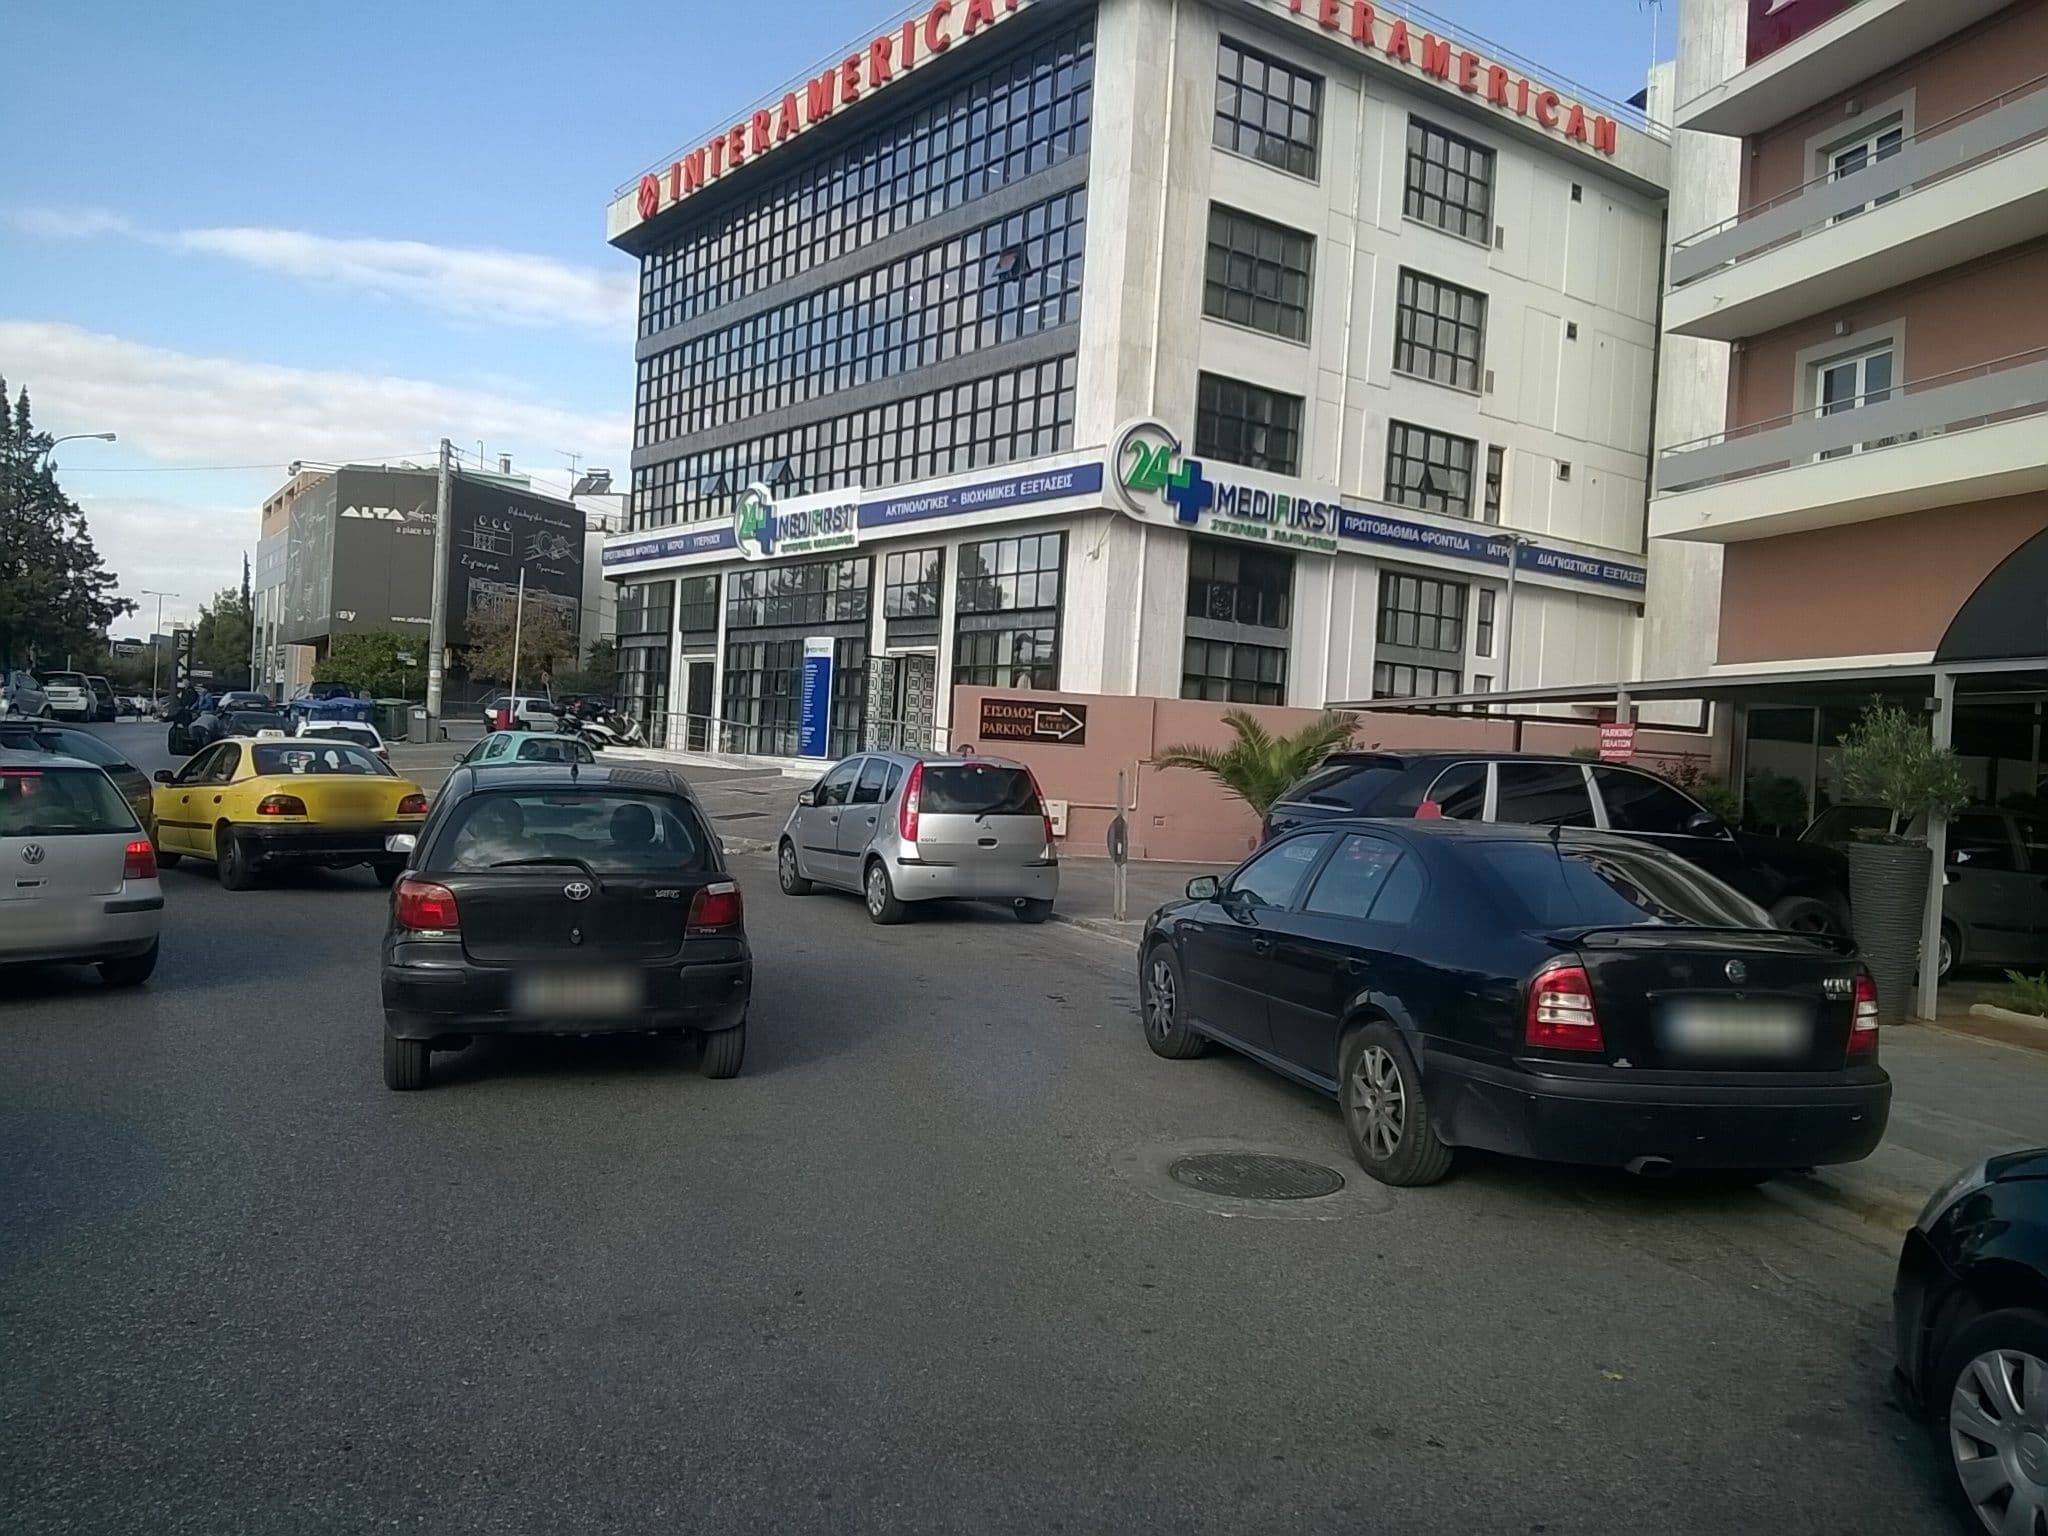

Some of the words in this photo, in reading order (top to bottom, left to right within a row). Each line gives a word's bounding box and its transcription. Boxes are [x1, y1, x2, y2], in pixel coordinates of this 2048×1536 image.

[669, 0, 1018, 201] INTERAMERICA
[1289, 0, 1617, 156] ERAMERICAN
[1124, 440, 1171, 493] 24
[340, 505, 405, 521] ALTA
[885, 498, 950, 517] ΑΚΤΙΝΟΛΟΓΙΚΕΣ
[960, 484, 1016, 506] ΒΙΟΧΗΜΙΚΕΣ
[1020, 473, 1073, 496] ΕΞΕΤΑΣΕΙΣ
[1213, 481, 1342, 533] MEDIFIRST
[777, 503, 857, 541] MEDIFIRST
[1344, 516, 1420, 542] ΠΡΩΤΟΒΑΘΜΙΑ
[1421, 532, 1470, 551] ΦΡΟΝΤΙΔΑ
[1537, 553, 1600, 576] ΔΙΑΓΝΩΣΤΙΚΕΣ
[1603, 567, 1645, 585] ΕΞΕΤΑΣΕΙΣ
[982, 721, 1032, 736] PARKING
[983, 704, 1036, 719] ΕΙΣΟΔΟΣ
